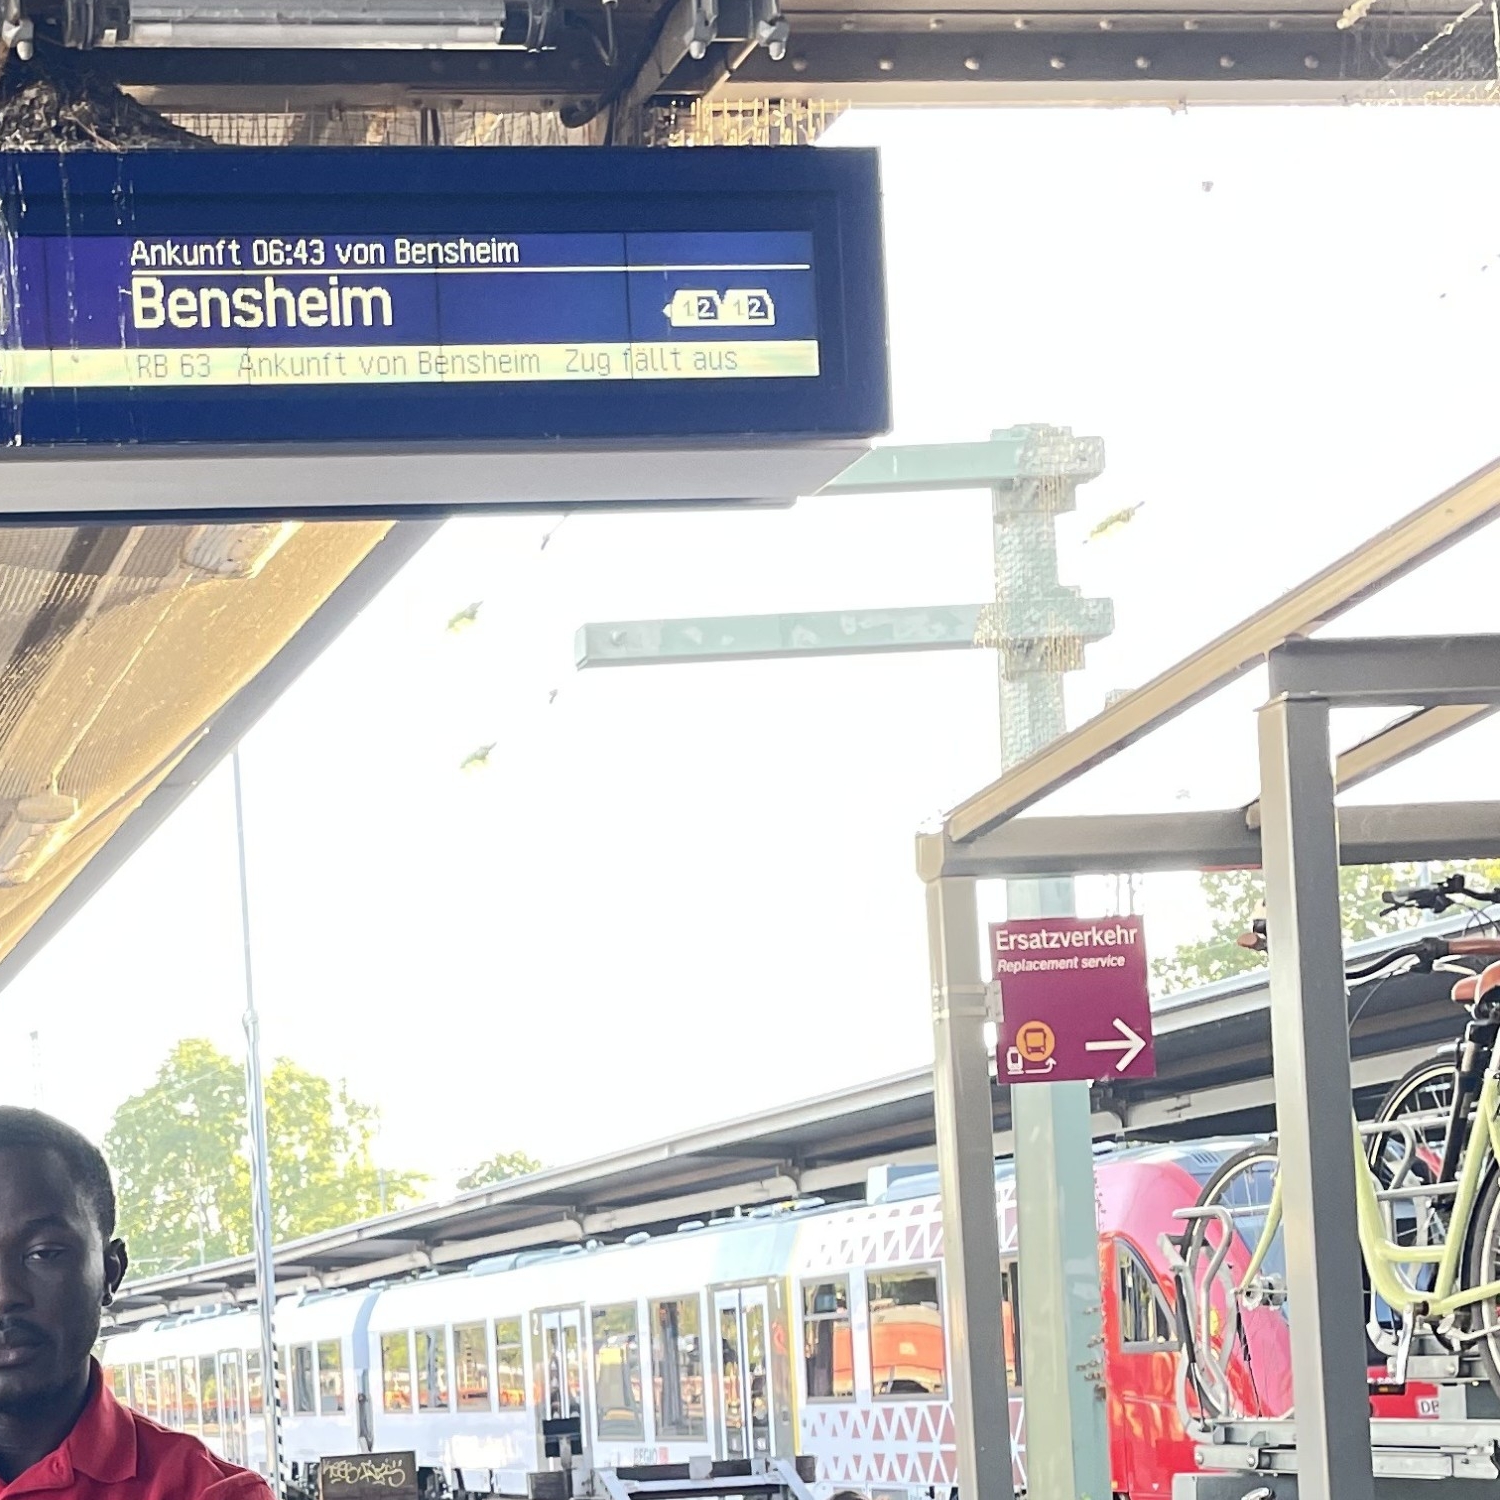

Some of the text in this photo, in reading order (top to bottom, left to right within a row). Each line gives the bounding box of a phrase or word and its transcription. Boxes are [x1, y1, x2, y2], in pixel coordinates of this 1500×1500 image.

[130, 237, 520, 266] Ankunft 06:43 von Bensheim
[131, 275, 394, 329] Bensheim
[137, 347, 739, 379] RB 63 Ankunft von Bensheim Zug fällt aus
[995, 924, 1138, 951] Ersatzverkehr
[997, 954, 1125, 975] Replacement service
